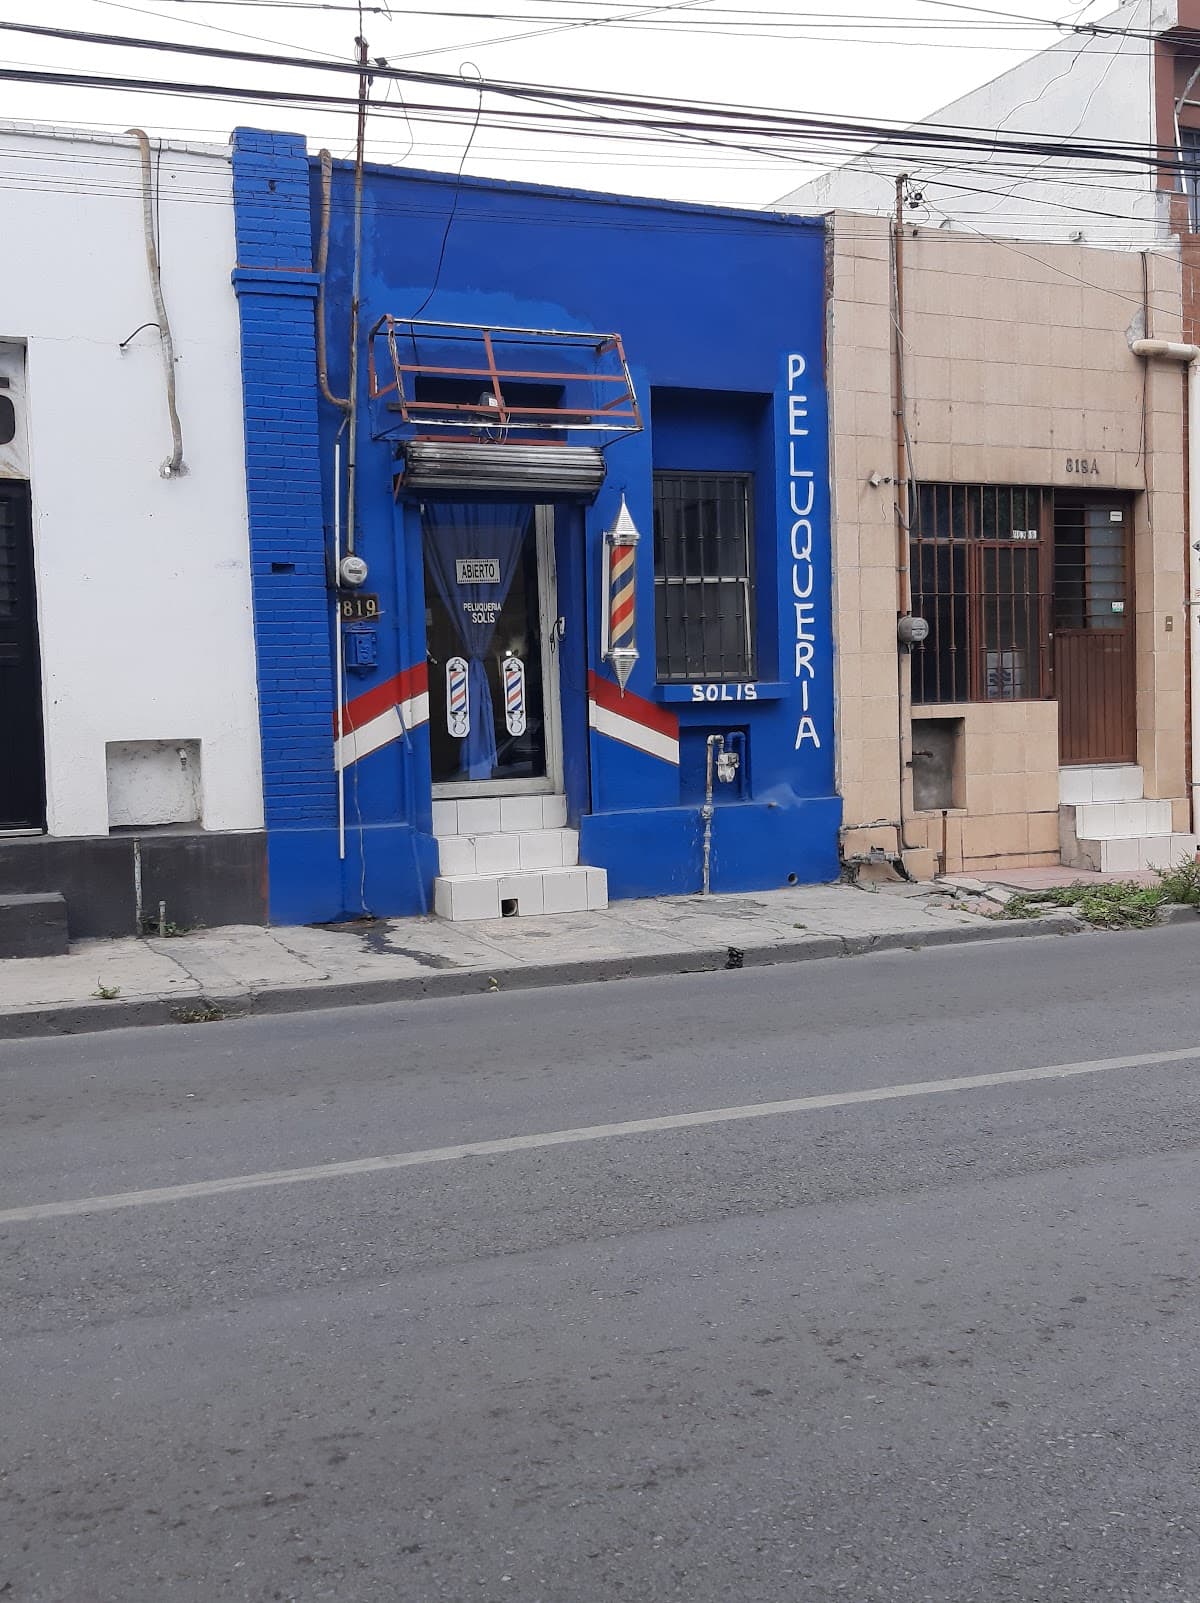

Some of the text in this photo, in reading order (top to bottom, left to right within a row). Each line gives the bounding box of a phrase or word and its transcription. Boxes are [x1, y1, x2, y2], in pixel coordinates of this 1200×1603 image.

[787, 353, 821, 751] PELUQUERIA
[462, 563, 495, 578] ABIERTO
[343, 599, 376, 617] 819
[463, 602, 502, 612] PELUQUERIA
[472, 612, 496, 624] SOLIS
[691, 683, 758, 702] SOLIS
